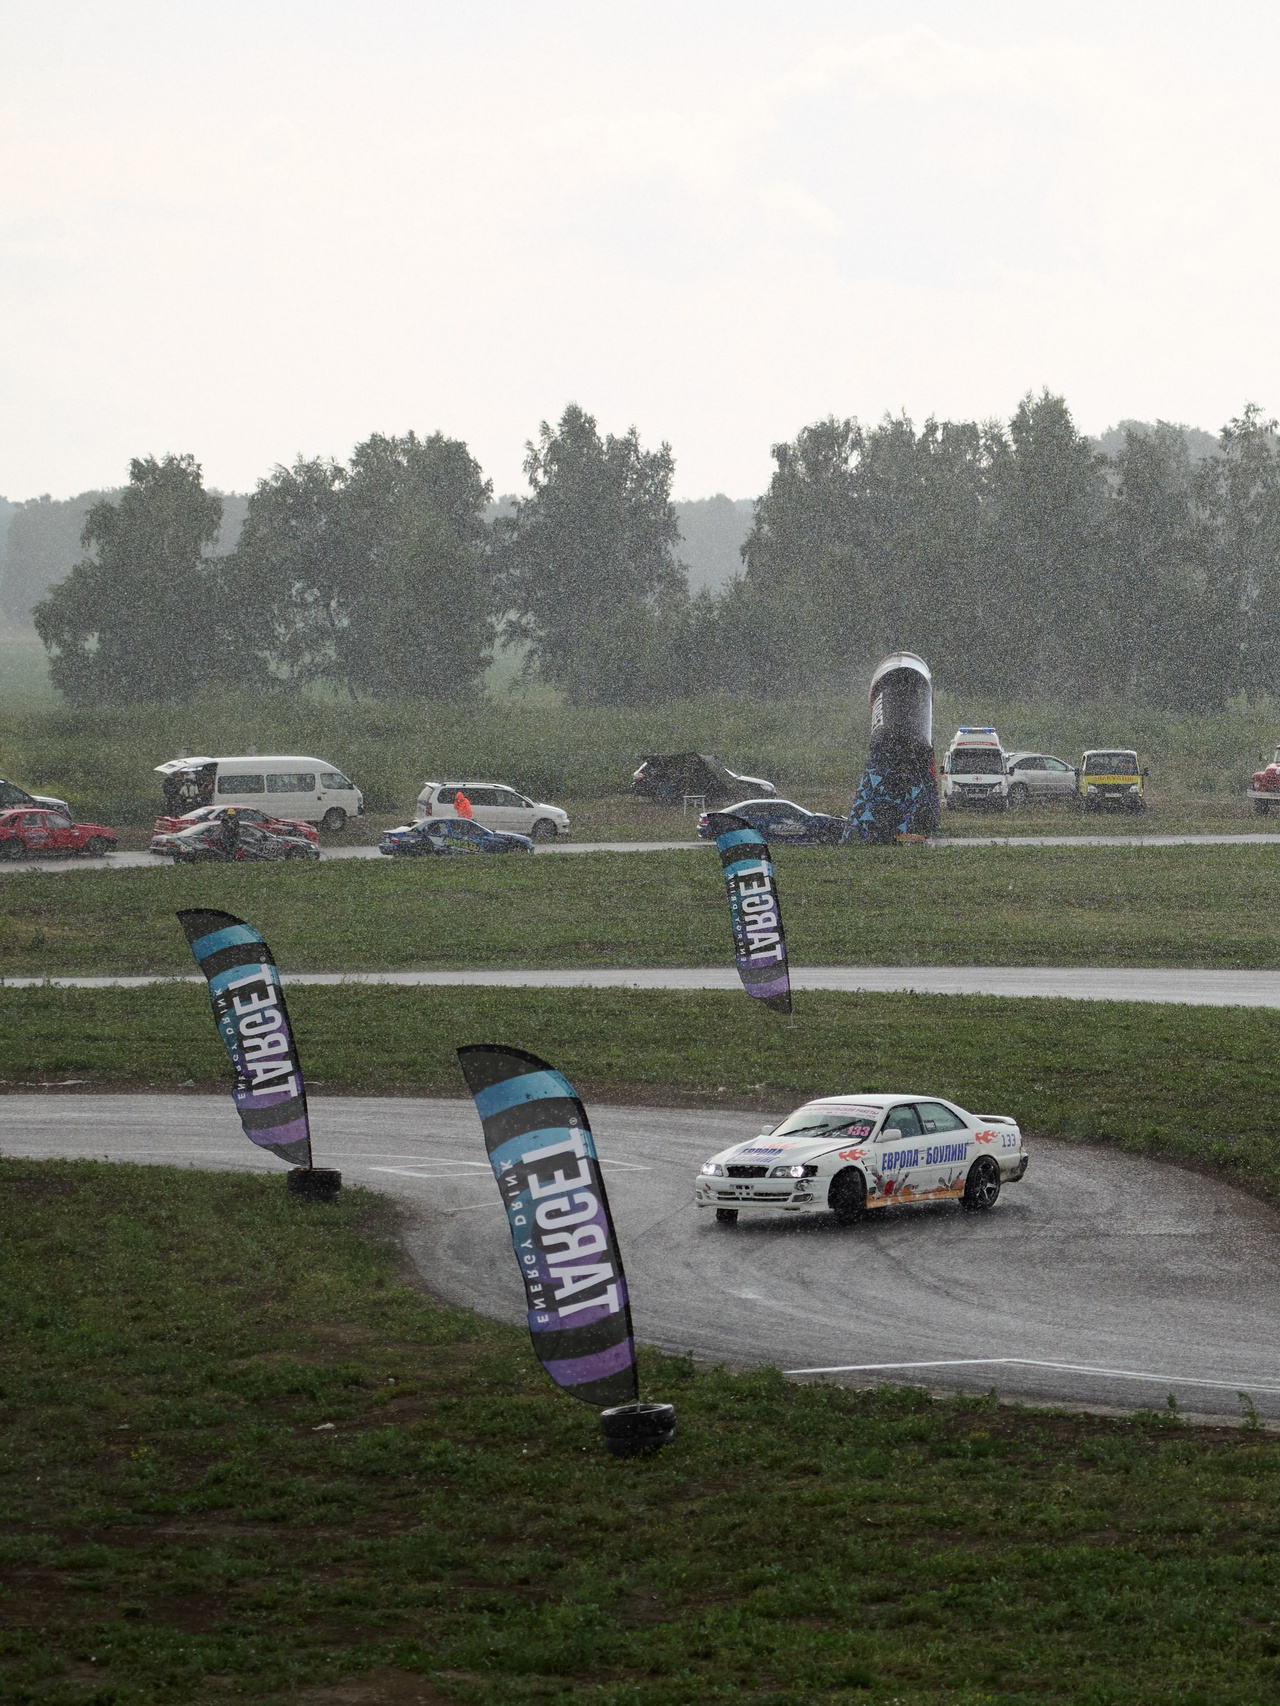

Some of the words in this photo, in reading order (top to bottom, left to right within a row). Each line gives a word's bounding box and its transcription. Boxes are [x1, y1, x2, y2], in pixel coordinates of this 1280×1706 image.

[846, 1125, 871, 1137] 133
[1001, 1133, 1017, 1148] 133
[881, 1148, 919, 1171] ЕВРОПА
[926, 1142, 969, 1166] БОУЛИНГ
